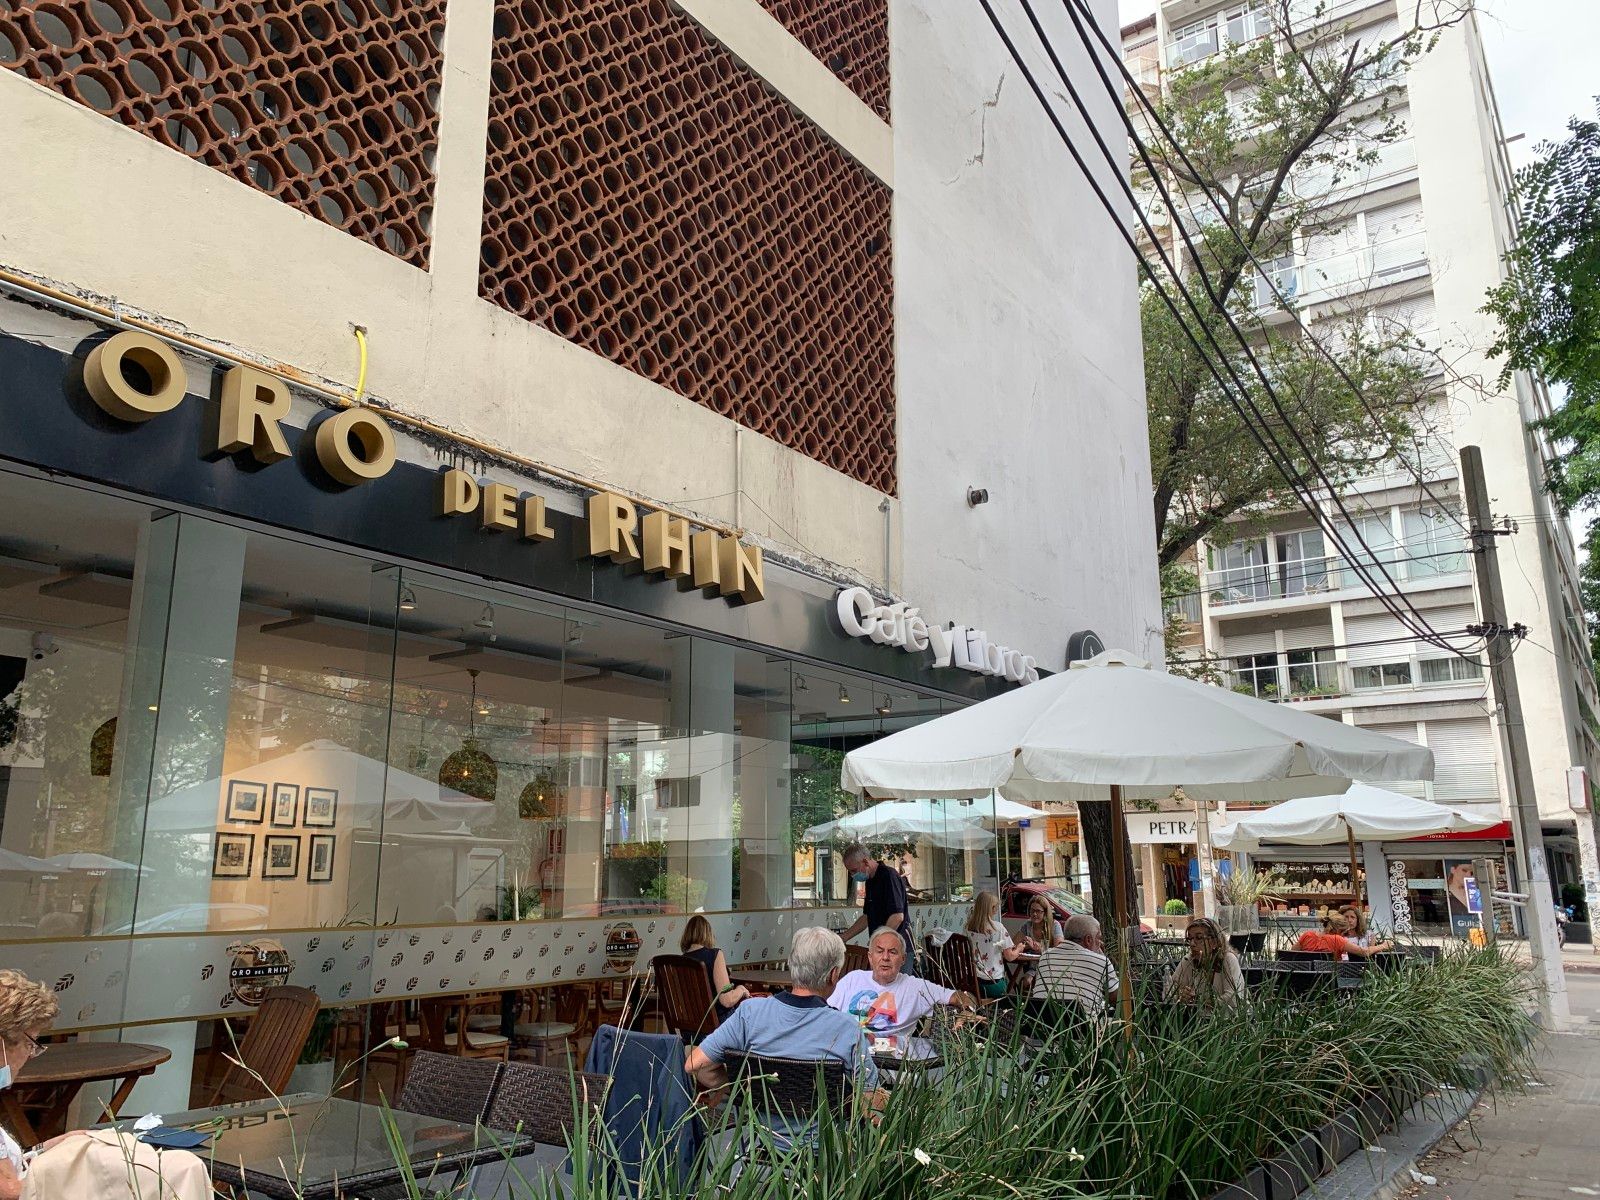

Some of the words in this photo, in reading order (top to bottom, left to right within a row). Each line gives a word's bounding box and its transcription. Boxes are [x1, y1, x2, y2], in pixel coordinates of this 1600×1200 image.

[84, 331, 396, 485] ORO
[444, 469, 555, 542] DEL
[589, 491, 764, 602] RHIN
[1149, 821, 1197, 834] PETRA
[231, 969, 251, 977] ORO
[267, 966, 288, 974] RHIN
